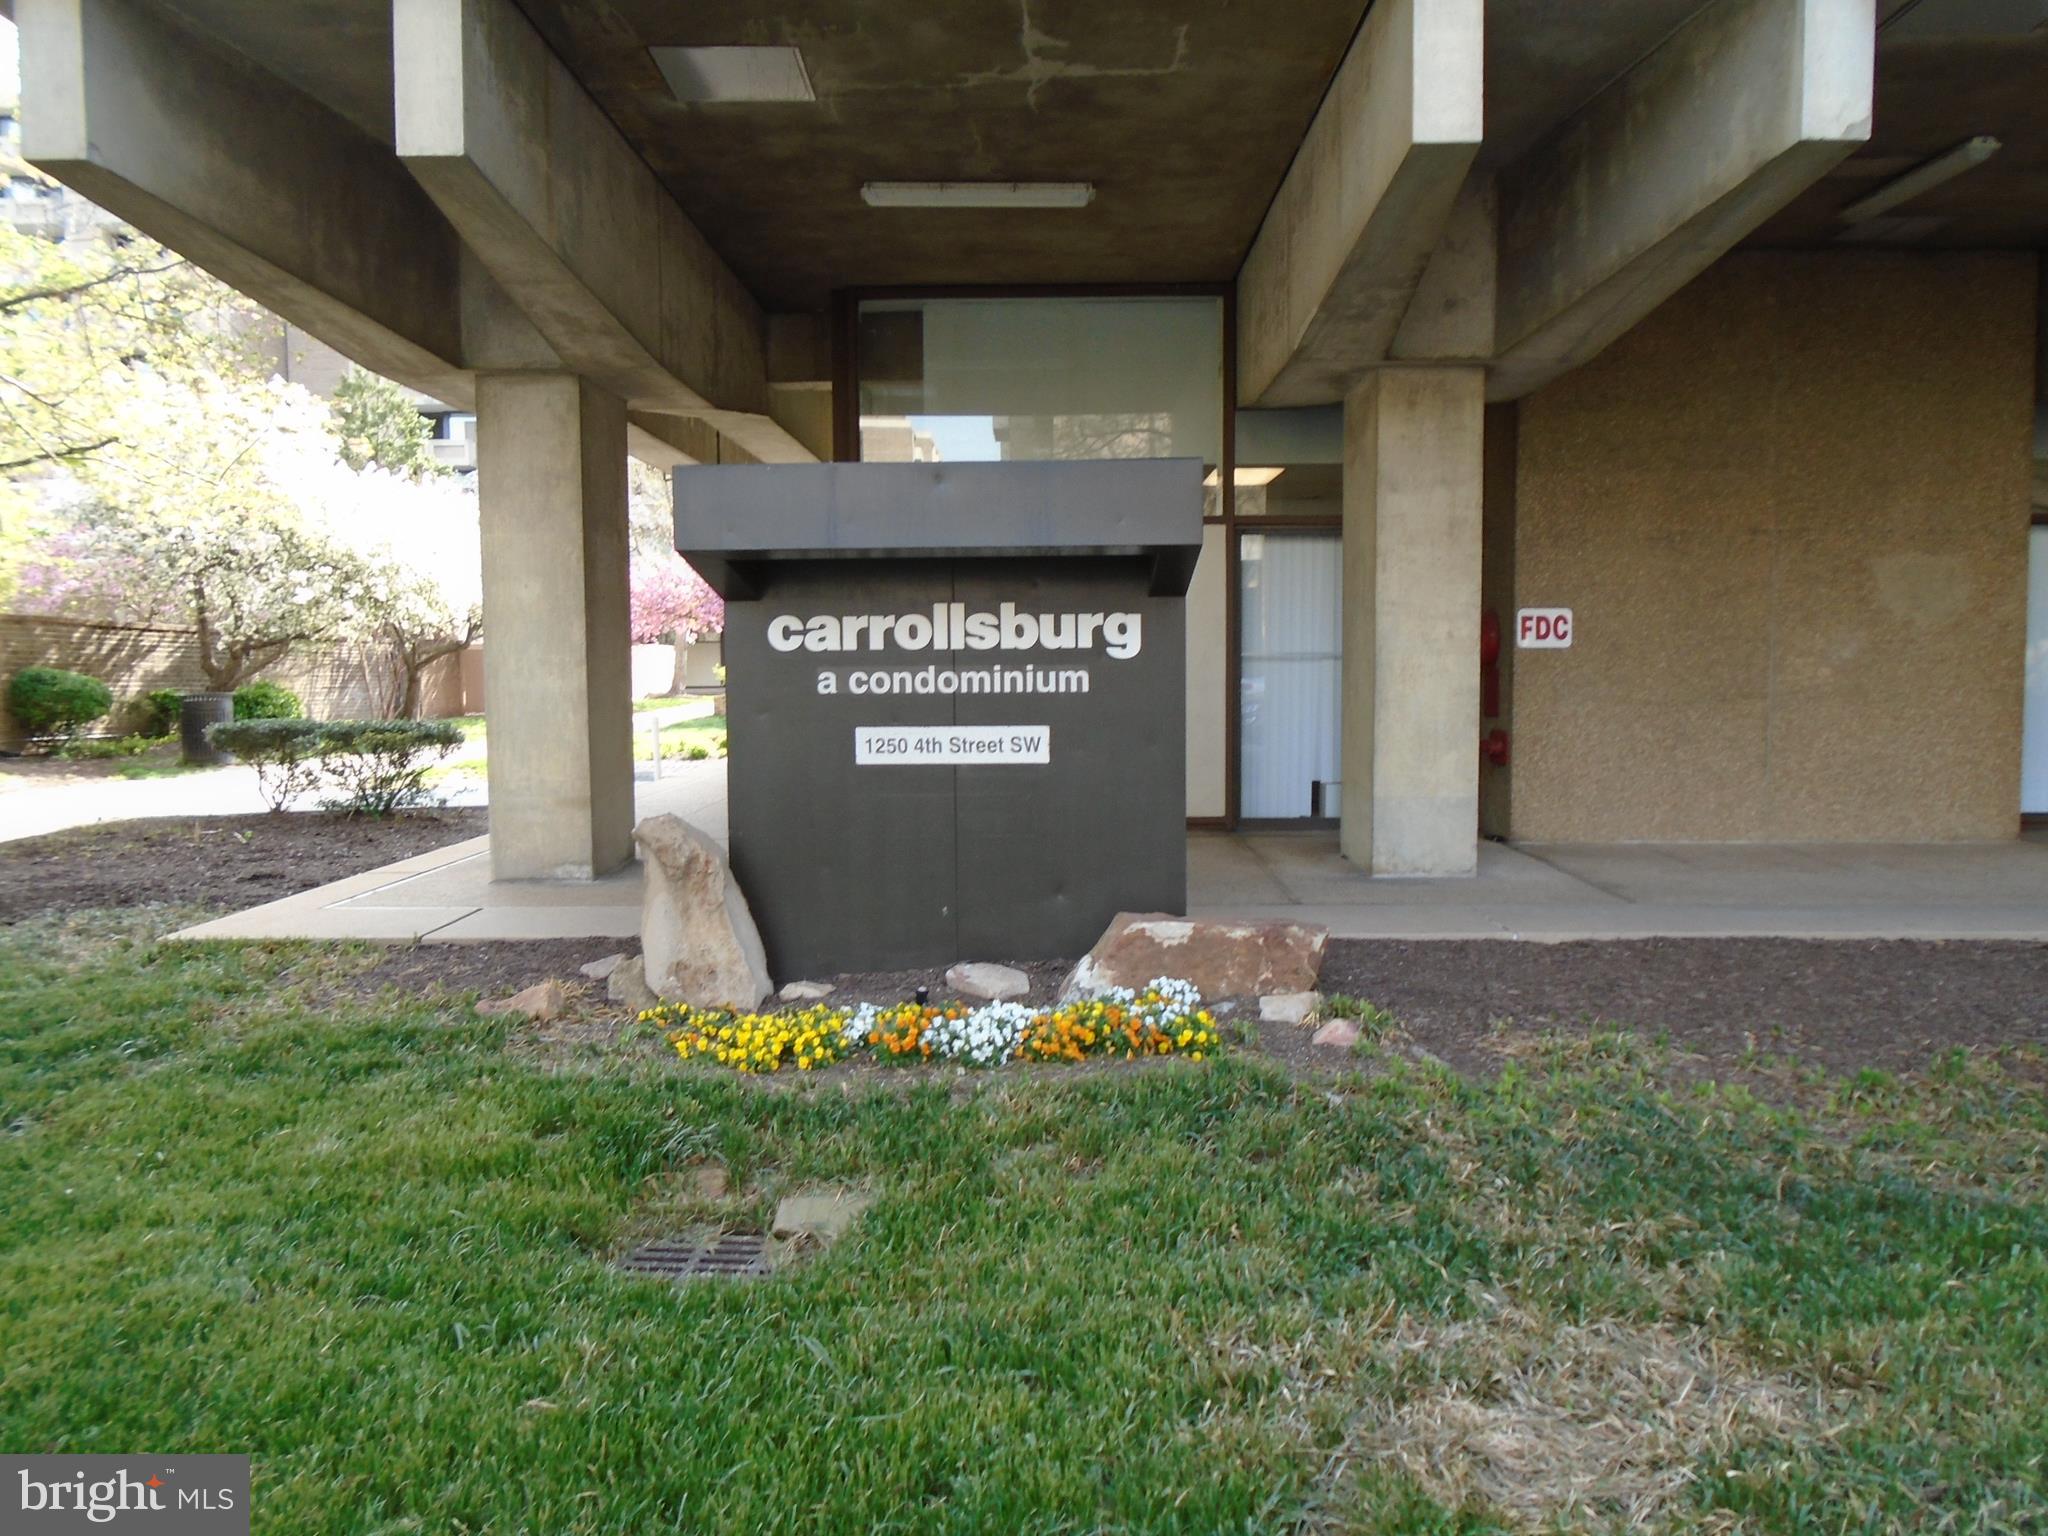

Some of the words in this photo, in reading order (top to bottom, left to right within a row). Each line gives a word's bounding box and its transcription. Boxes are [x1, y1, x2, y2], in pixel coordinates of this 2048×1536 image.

[767, 602, 1142, 660] carrollsburg
[1521, 615, 1569, 641] FDC
[817, 671, 838, 695] a
[848, 663, 1090, 695] condominium
[865, 737, 908, 754] 1250
[914, 737, 943, 754] 4th
[949, 737, 1004, 754] Street
[1010, 736, 1042, 754] SW
